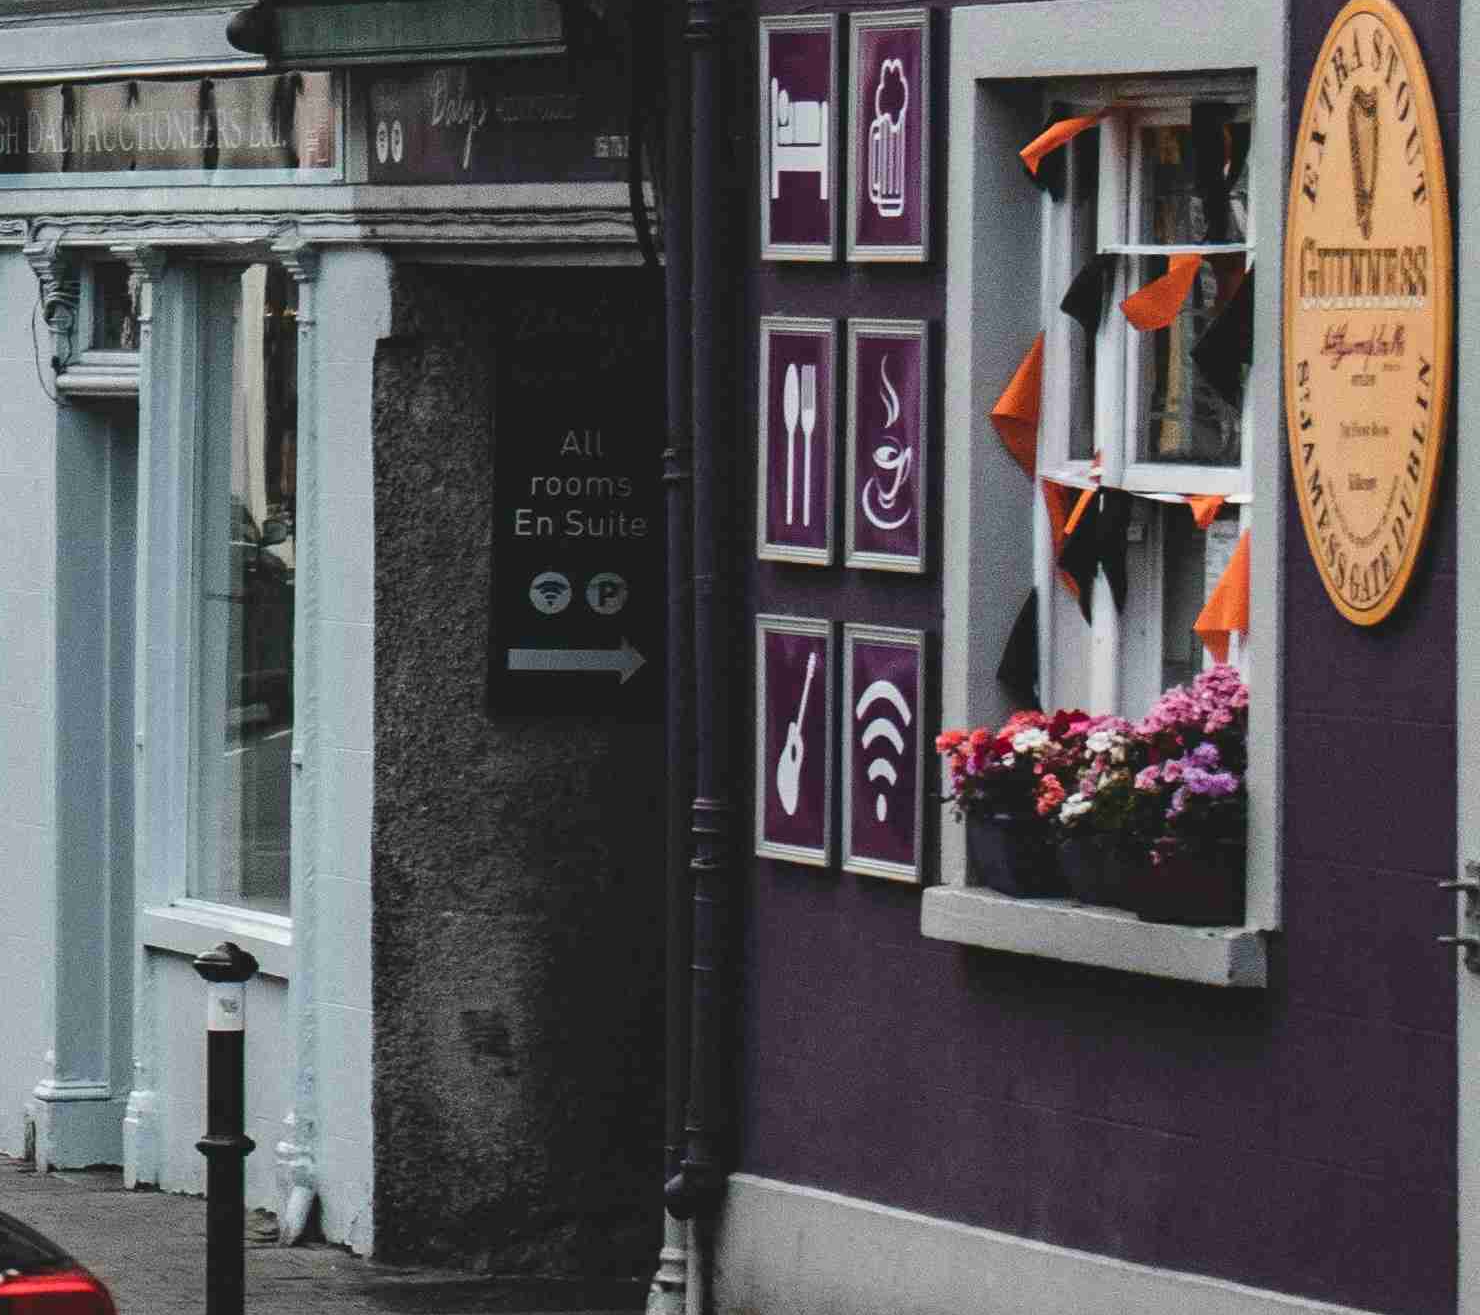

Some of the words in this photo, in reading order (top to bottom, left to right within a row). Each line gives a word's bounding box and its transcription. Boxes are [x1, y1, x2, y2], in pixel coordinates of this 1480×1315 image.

[560, 429, 604, 460] All
[529, 474, 634, 498] rooms
[513, 508, 554, 537] En
[565, 508, 649, 537] Suite
